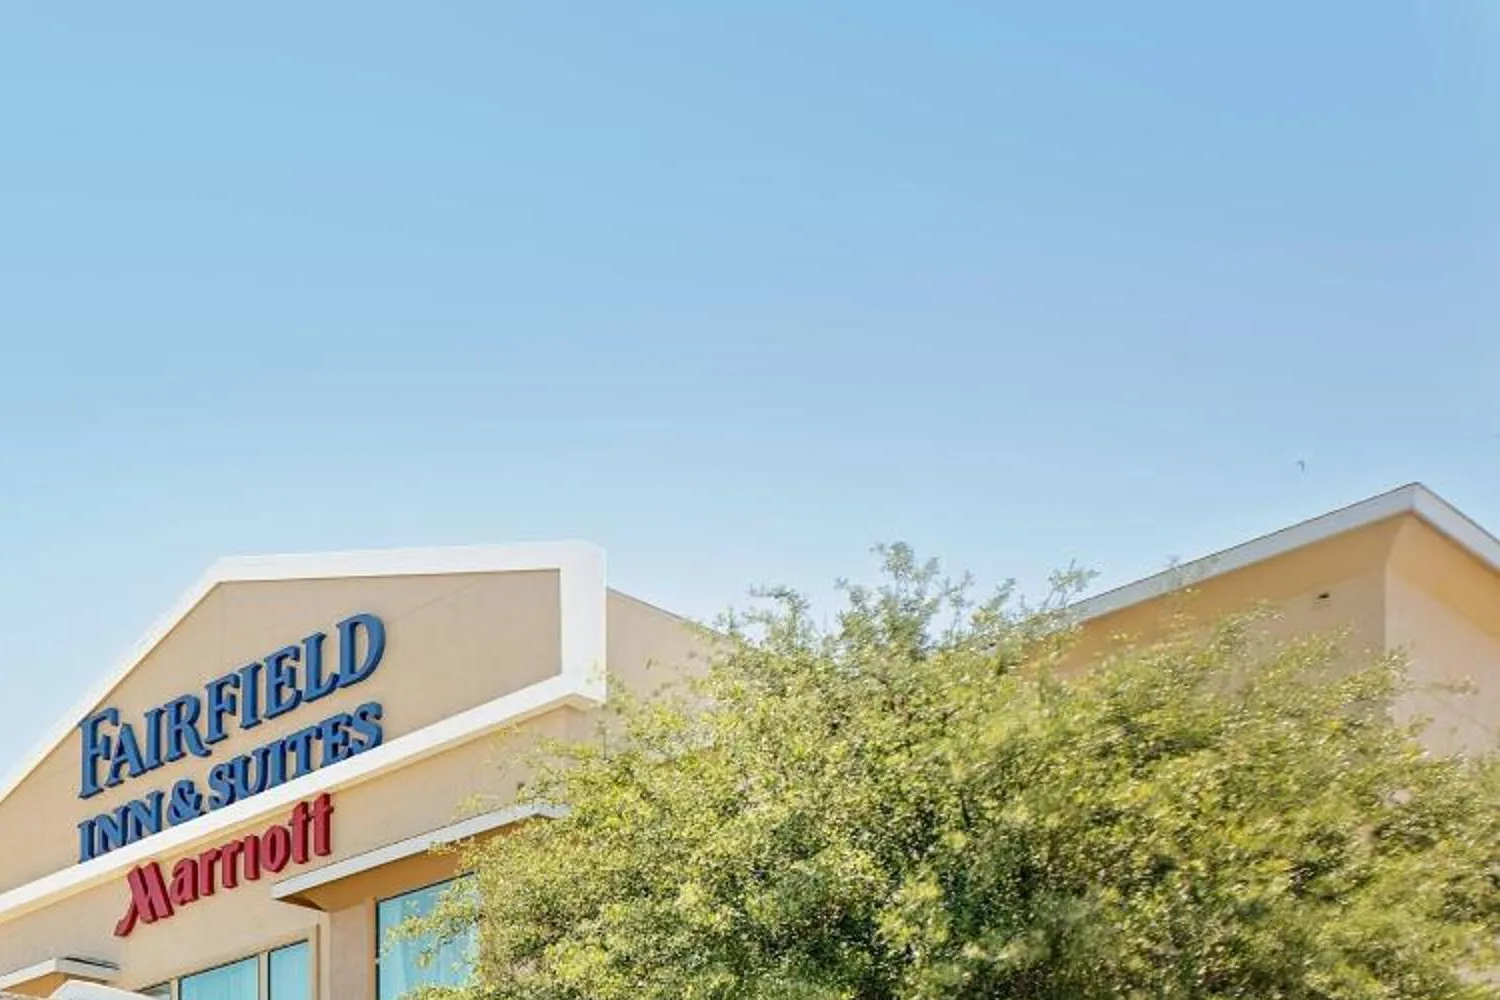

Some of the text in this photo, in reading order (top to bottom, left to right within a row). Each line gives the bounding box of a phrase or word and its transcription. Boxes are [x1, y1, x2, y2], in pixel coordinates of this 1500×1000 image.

[77, 612, 386, 799] FAIRFIELD
[77, 701, 384, 863] INN & SUITES
[113, 791, 335, 938] Marriott
